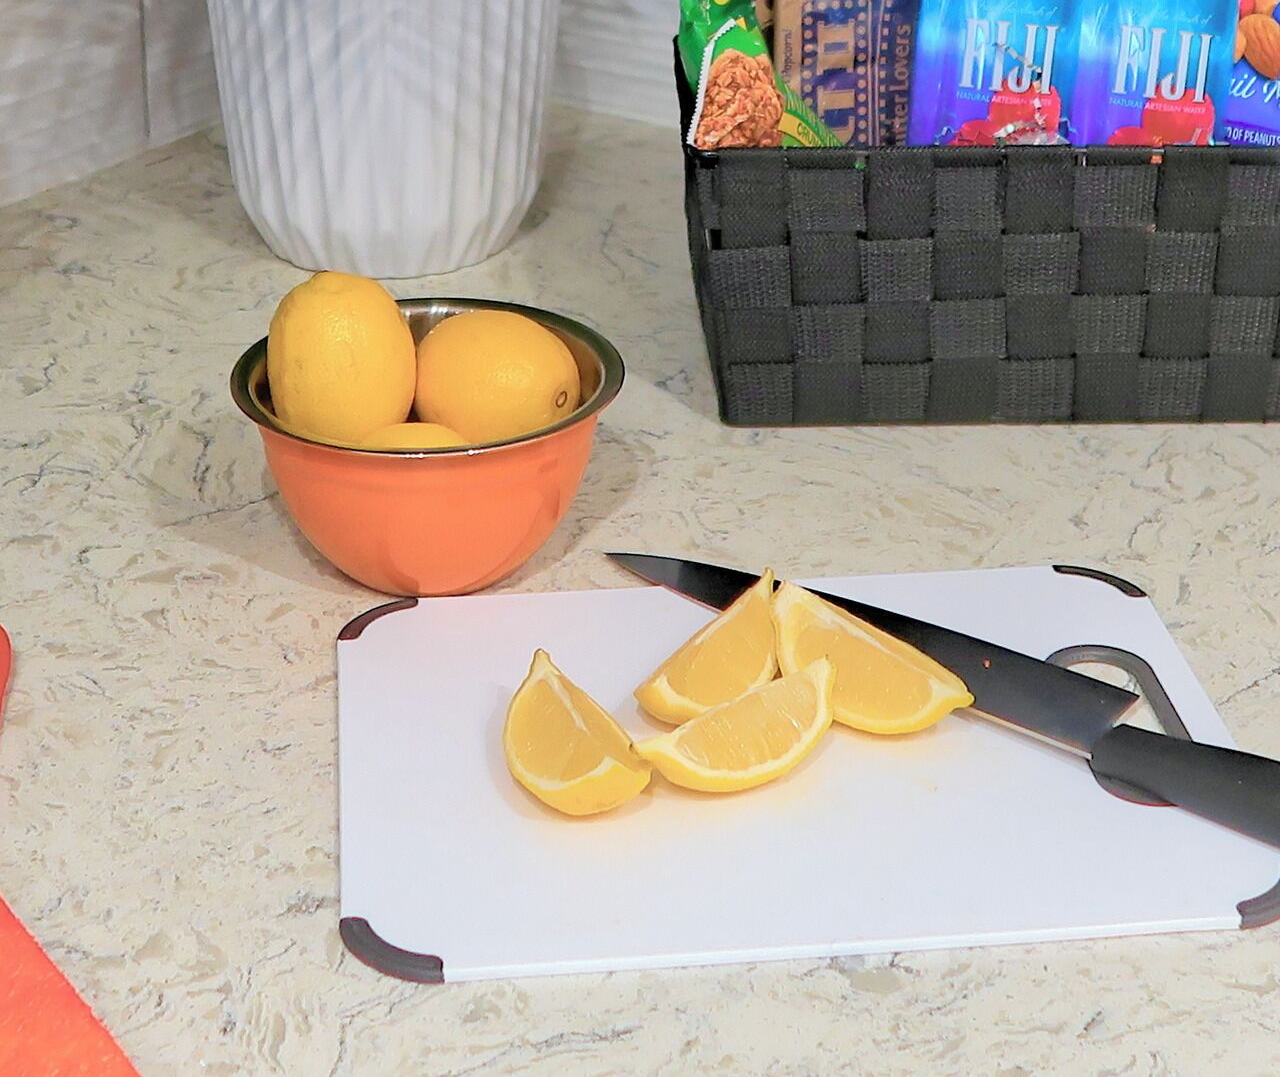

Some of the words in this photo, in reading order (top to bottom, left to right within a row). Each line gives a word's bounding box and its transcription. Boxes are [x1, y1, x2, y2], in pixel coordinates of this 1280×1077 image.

[888, 25, 912, 91] Lovers
[958, 18, 1060, 95] FIJI
[1111, 25, 1214, 103] FIJI
[890, 94, 909, 147] utter
[956, 91, 990, 103] NATURAL
[1109, 97, 1142, 108] NATURAL
[1144, 101, 1181, 113] ARTESIAN
[1183, 105, 1206, 114] WATER
[1232, 127, 1243, 141] OF
[1243, 130, 1280, 146] PEANUTS
